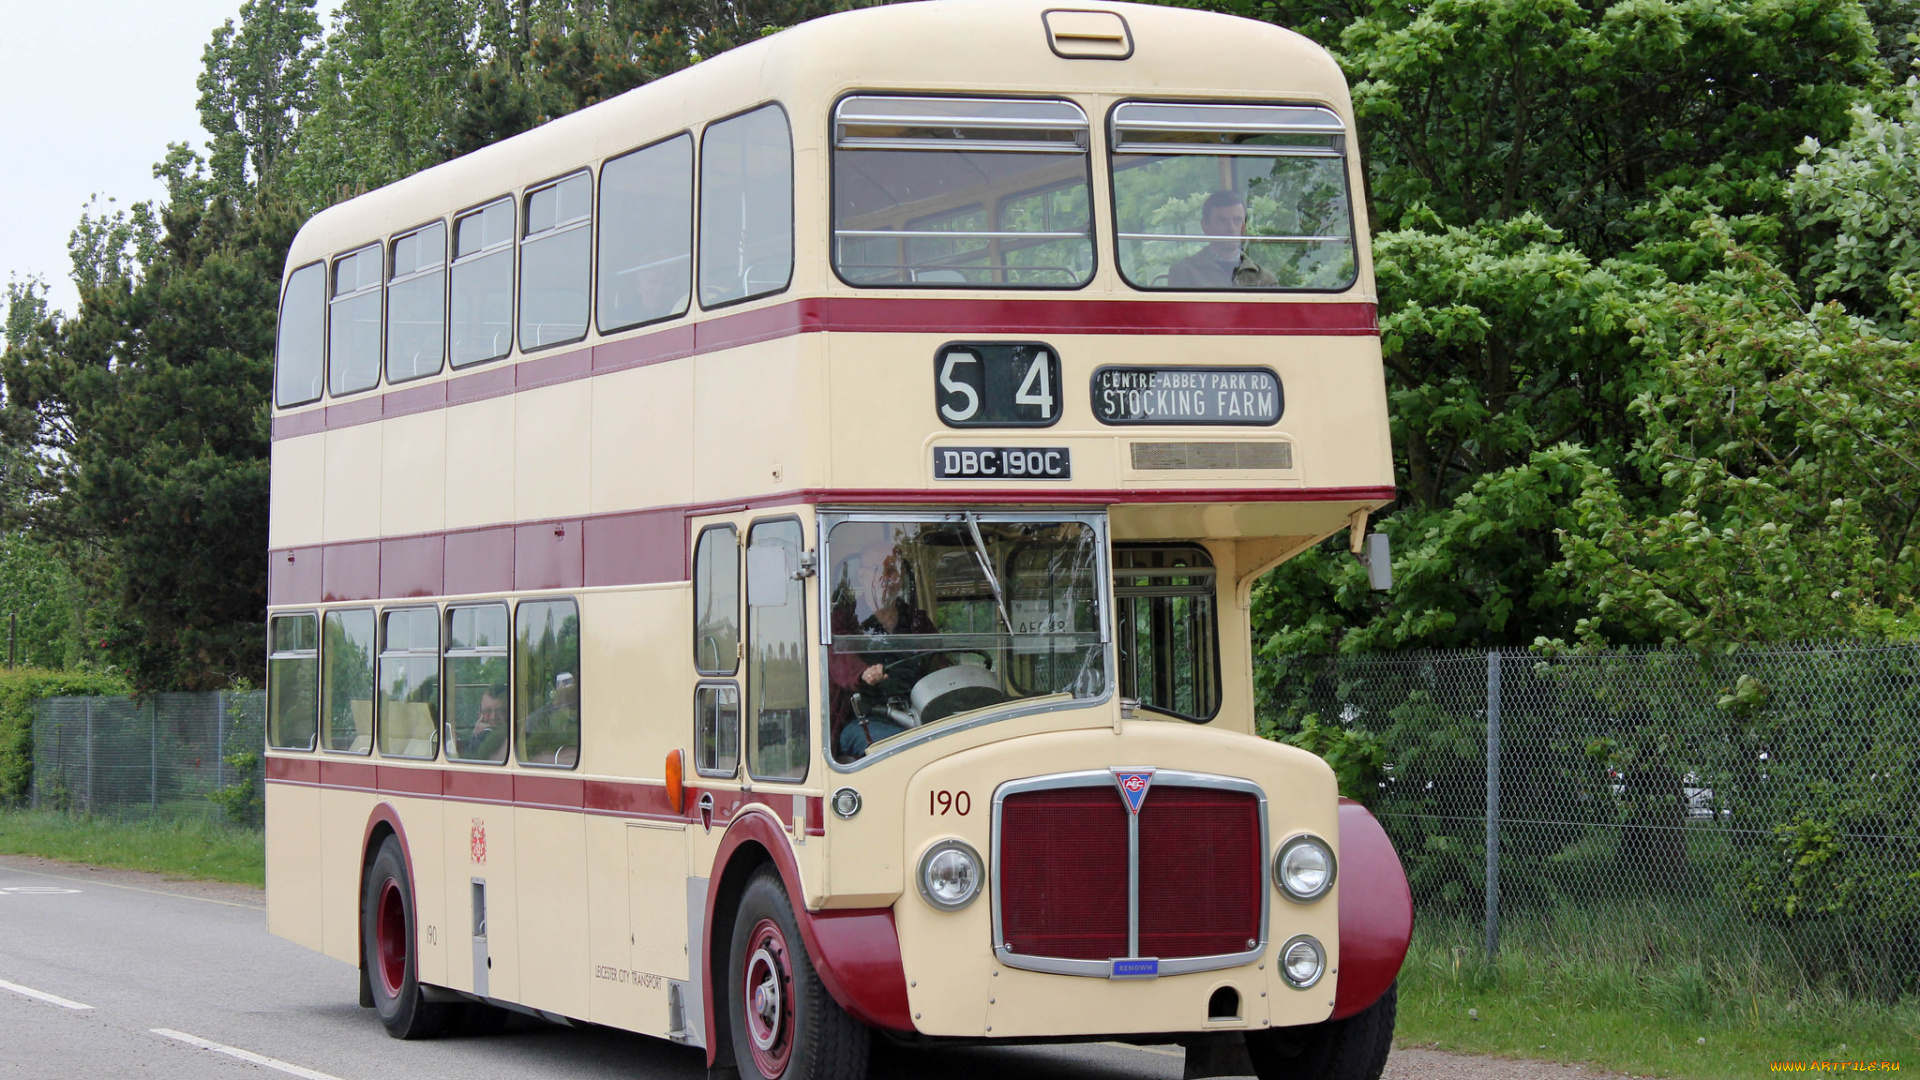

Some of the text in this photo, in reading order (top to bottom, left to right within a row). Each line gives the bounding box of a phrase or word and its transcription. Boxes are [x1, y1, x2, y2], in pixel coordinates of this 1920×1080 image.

[939, 350, 1053, 421] 5 4
[1102, 372, 1272, 390] CENTRE-ABBEY PARK RD.
[1103, 389, 1273, 417] STOCKING FARM
[943, 451, 1062, 475] DBC 190C
[930, 790, 971, 816] 190
[426, 923, 438, 946] 190
[594, 963, 662, 990] LEICESTER CITY TRANSPORT
[1118, 964, 1153, 972] RENOWN
